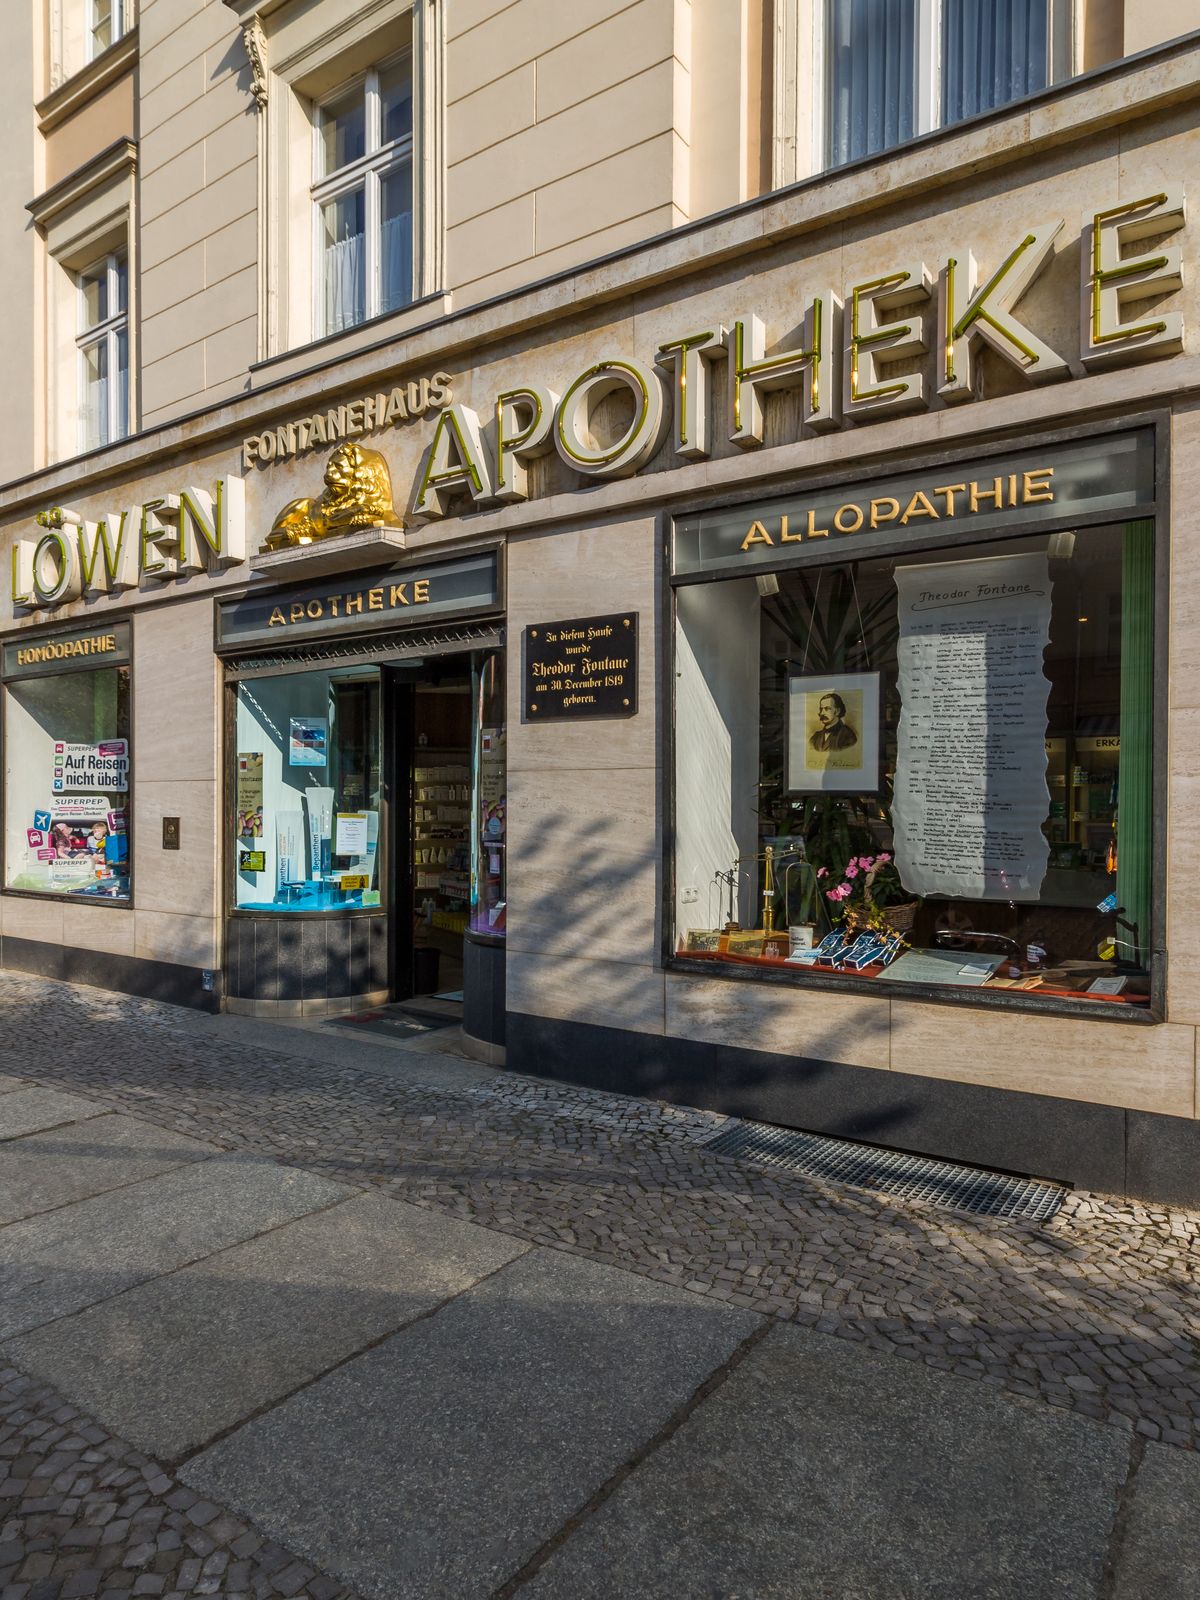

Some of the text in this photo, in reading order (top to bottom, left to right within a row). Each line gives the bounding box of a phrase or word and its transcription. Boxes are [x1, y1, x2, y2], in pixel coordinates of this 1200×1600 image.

[11, 185, 1188, 610] LÖWEN APOTHEKE
[242, 371, 454, 470] FONTANEHAUS
[740, 467, 1056, 552] ALLOPATHIE
[920, 583, 1032, 603] Theodor Fontane
[268, 579, 431, 629] APOTHEKE
[546, 632, 557, 642] In
[16, 633, 117, 667] HOMÖOPATHIE
[565, 644, 592, 655] wurde
[531, 656, 629, 678] Theodor Fontane
[535, 683, 548, 692] am
[550, 680, 562, 691] 30.
[604, 675, 624, 687] 1819
[563, 694, 597, 707] geboren.
[64, 754, 127, 770] Auf Reisen
[66, 771, 125, 786] nicht übel.
[312, 834, 320, 871] Bepanthen
